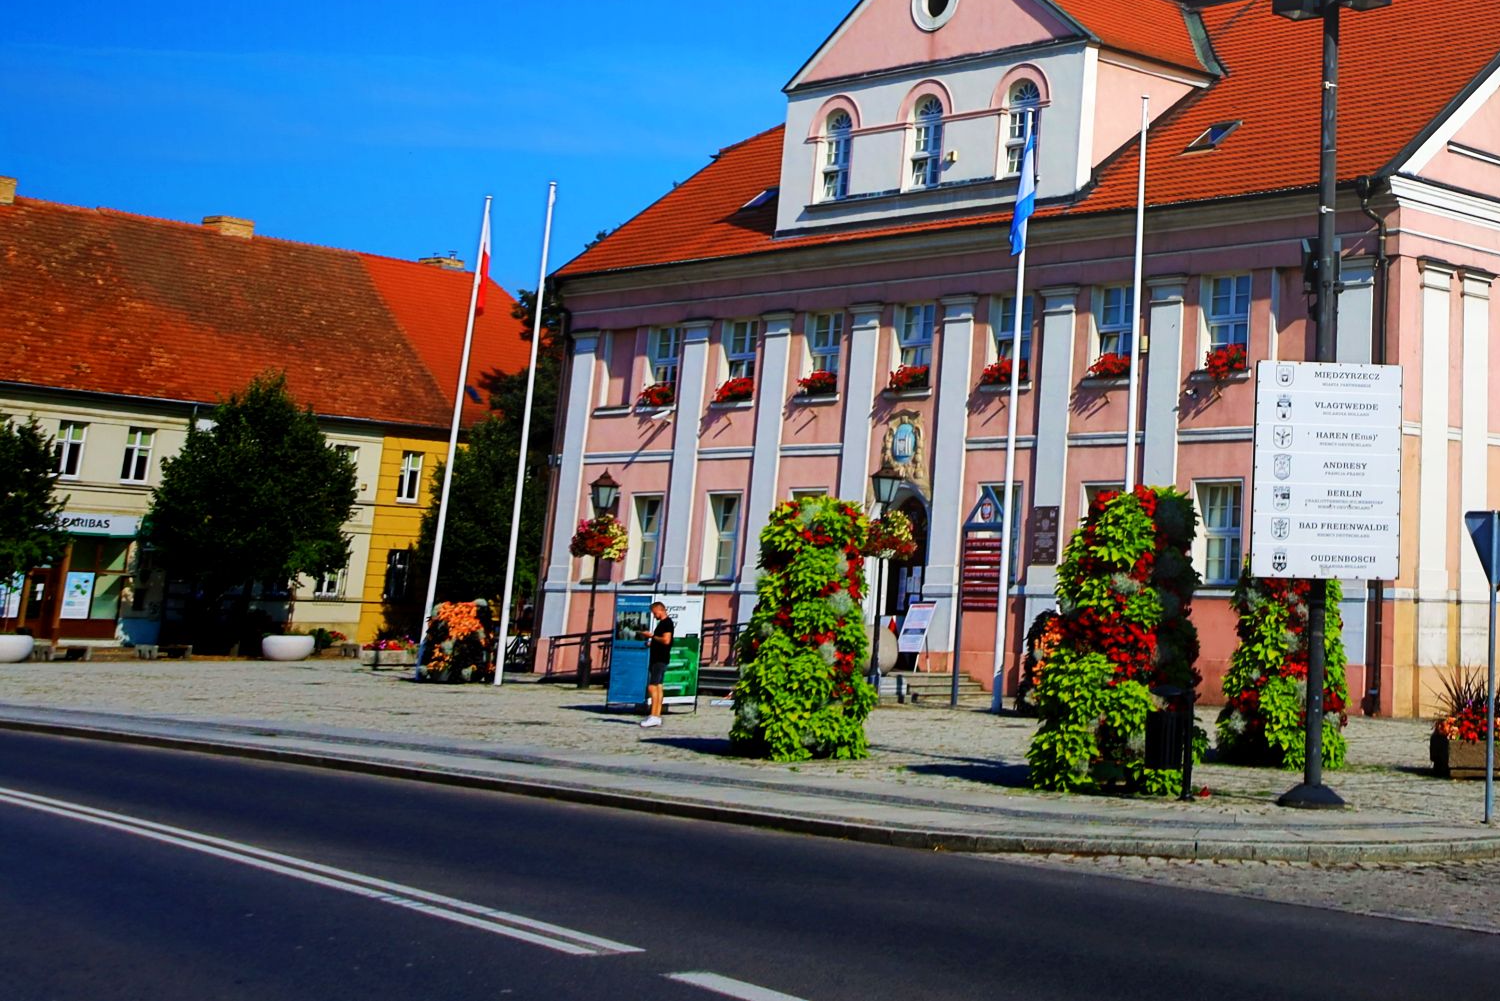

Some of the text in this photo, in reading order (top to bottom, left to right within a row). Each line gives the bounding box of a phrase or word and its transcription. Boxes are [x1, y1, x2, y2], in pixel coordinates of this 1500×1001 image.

[1314, 371, 1381, 381] MIĘDZYRZECZ
[1314, 401, 1379, 411] VLAGTWEDDE
[1316, 431, 1349, 440] HAREN
[1323, 462, 1368, 470] ANDRESY
[1327, 489, 1362, 498] BERLIN
[1299, 522, 1389, 532] BAD FREIENWALDE
[1310, 554, 1377, 563] OUDENBOSCH
